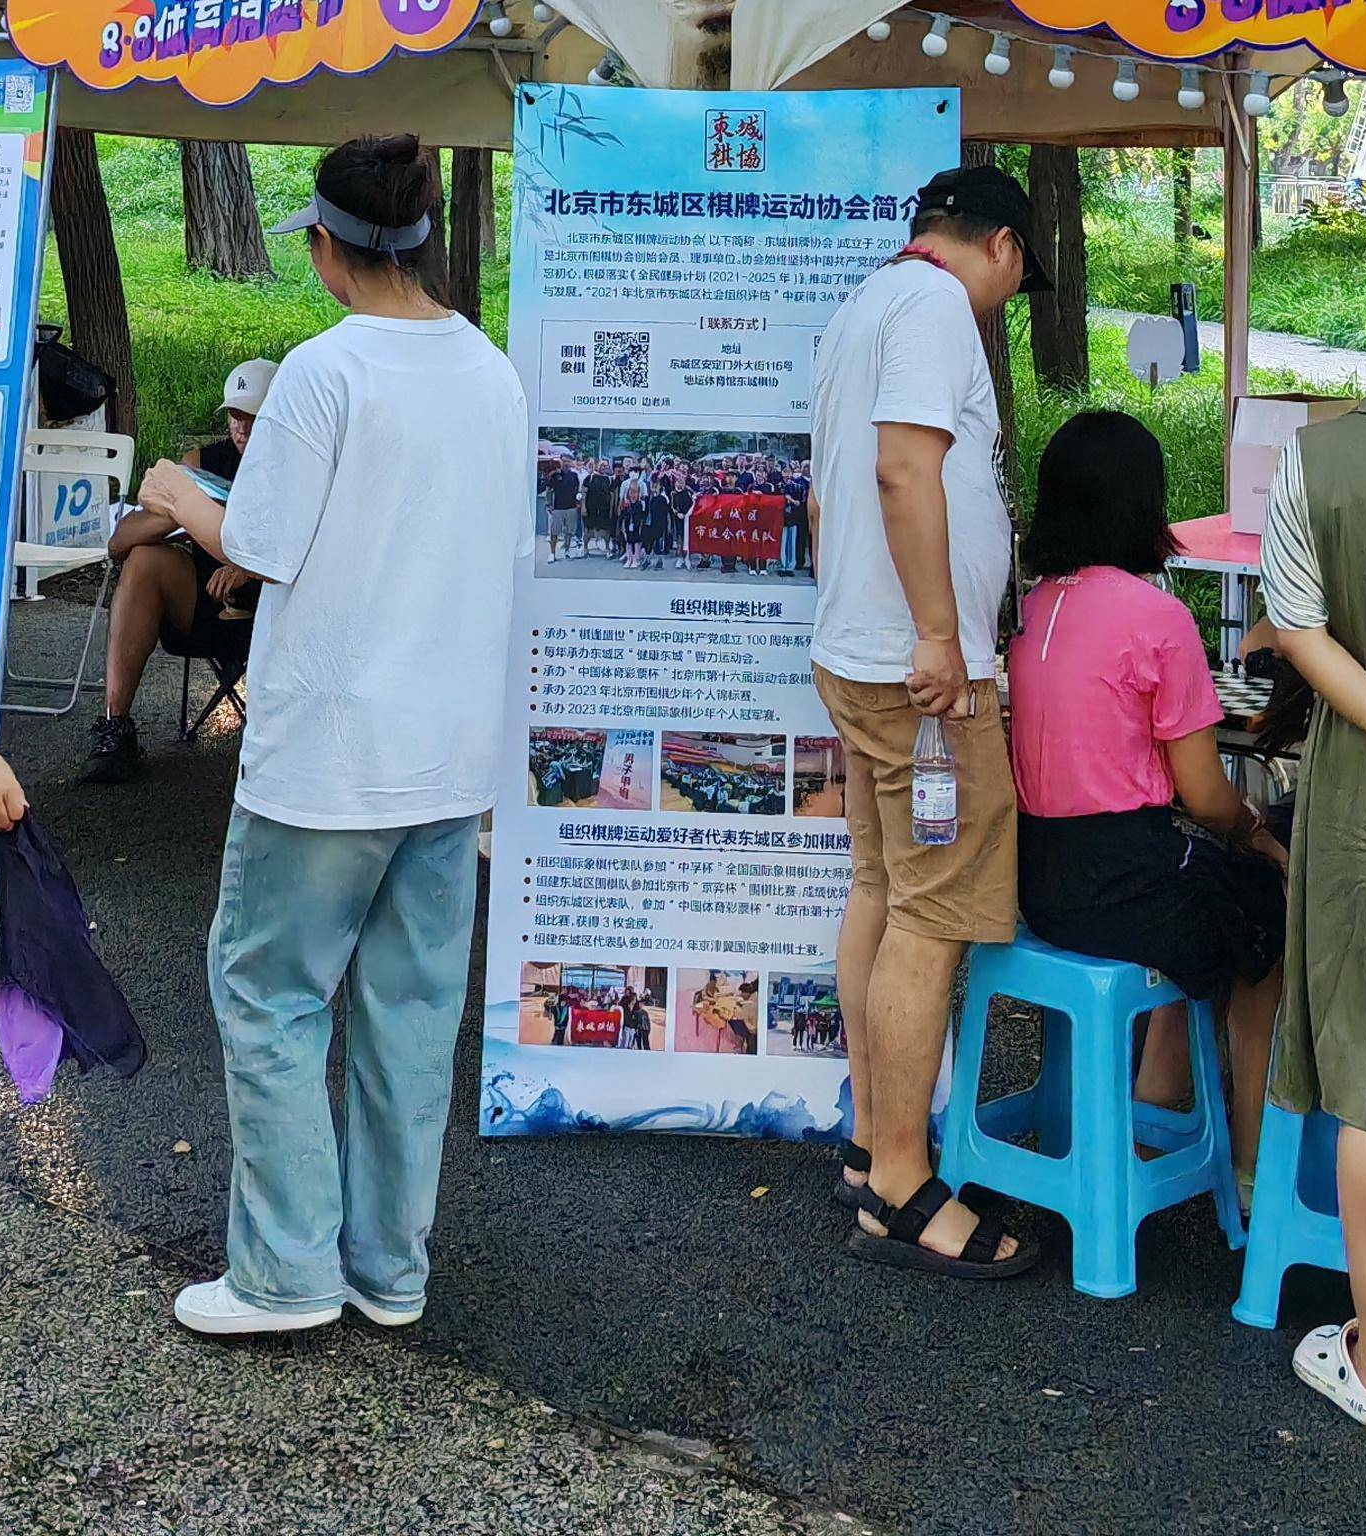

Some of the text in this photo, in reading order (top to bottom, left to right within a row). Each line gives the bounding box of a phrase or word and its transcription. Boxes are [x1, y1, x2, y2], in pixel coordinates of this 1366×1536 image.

[544, 188, 922, 223] 北京市东城区棋牌运动协会简介
[560, 345, 587, 359] 围棋
[560, 361, 587, 375] 象棋
[670, 598, 783, 618] 组织棋牌类比赛
